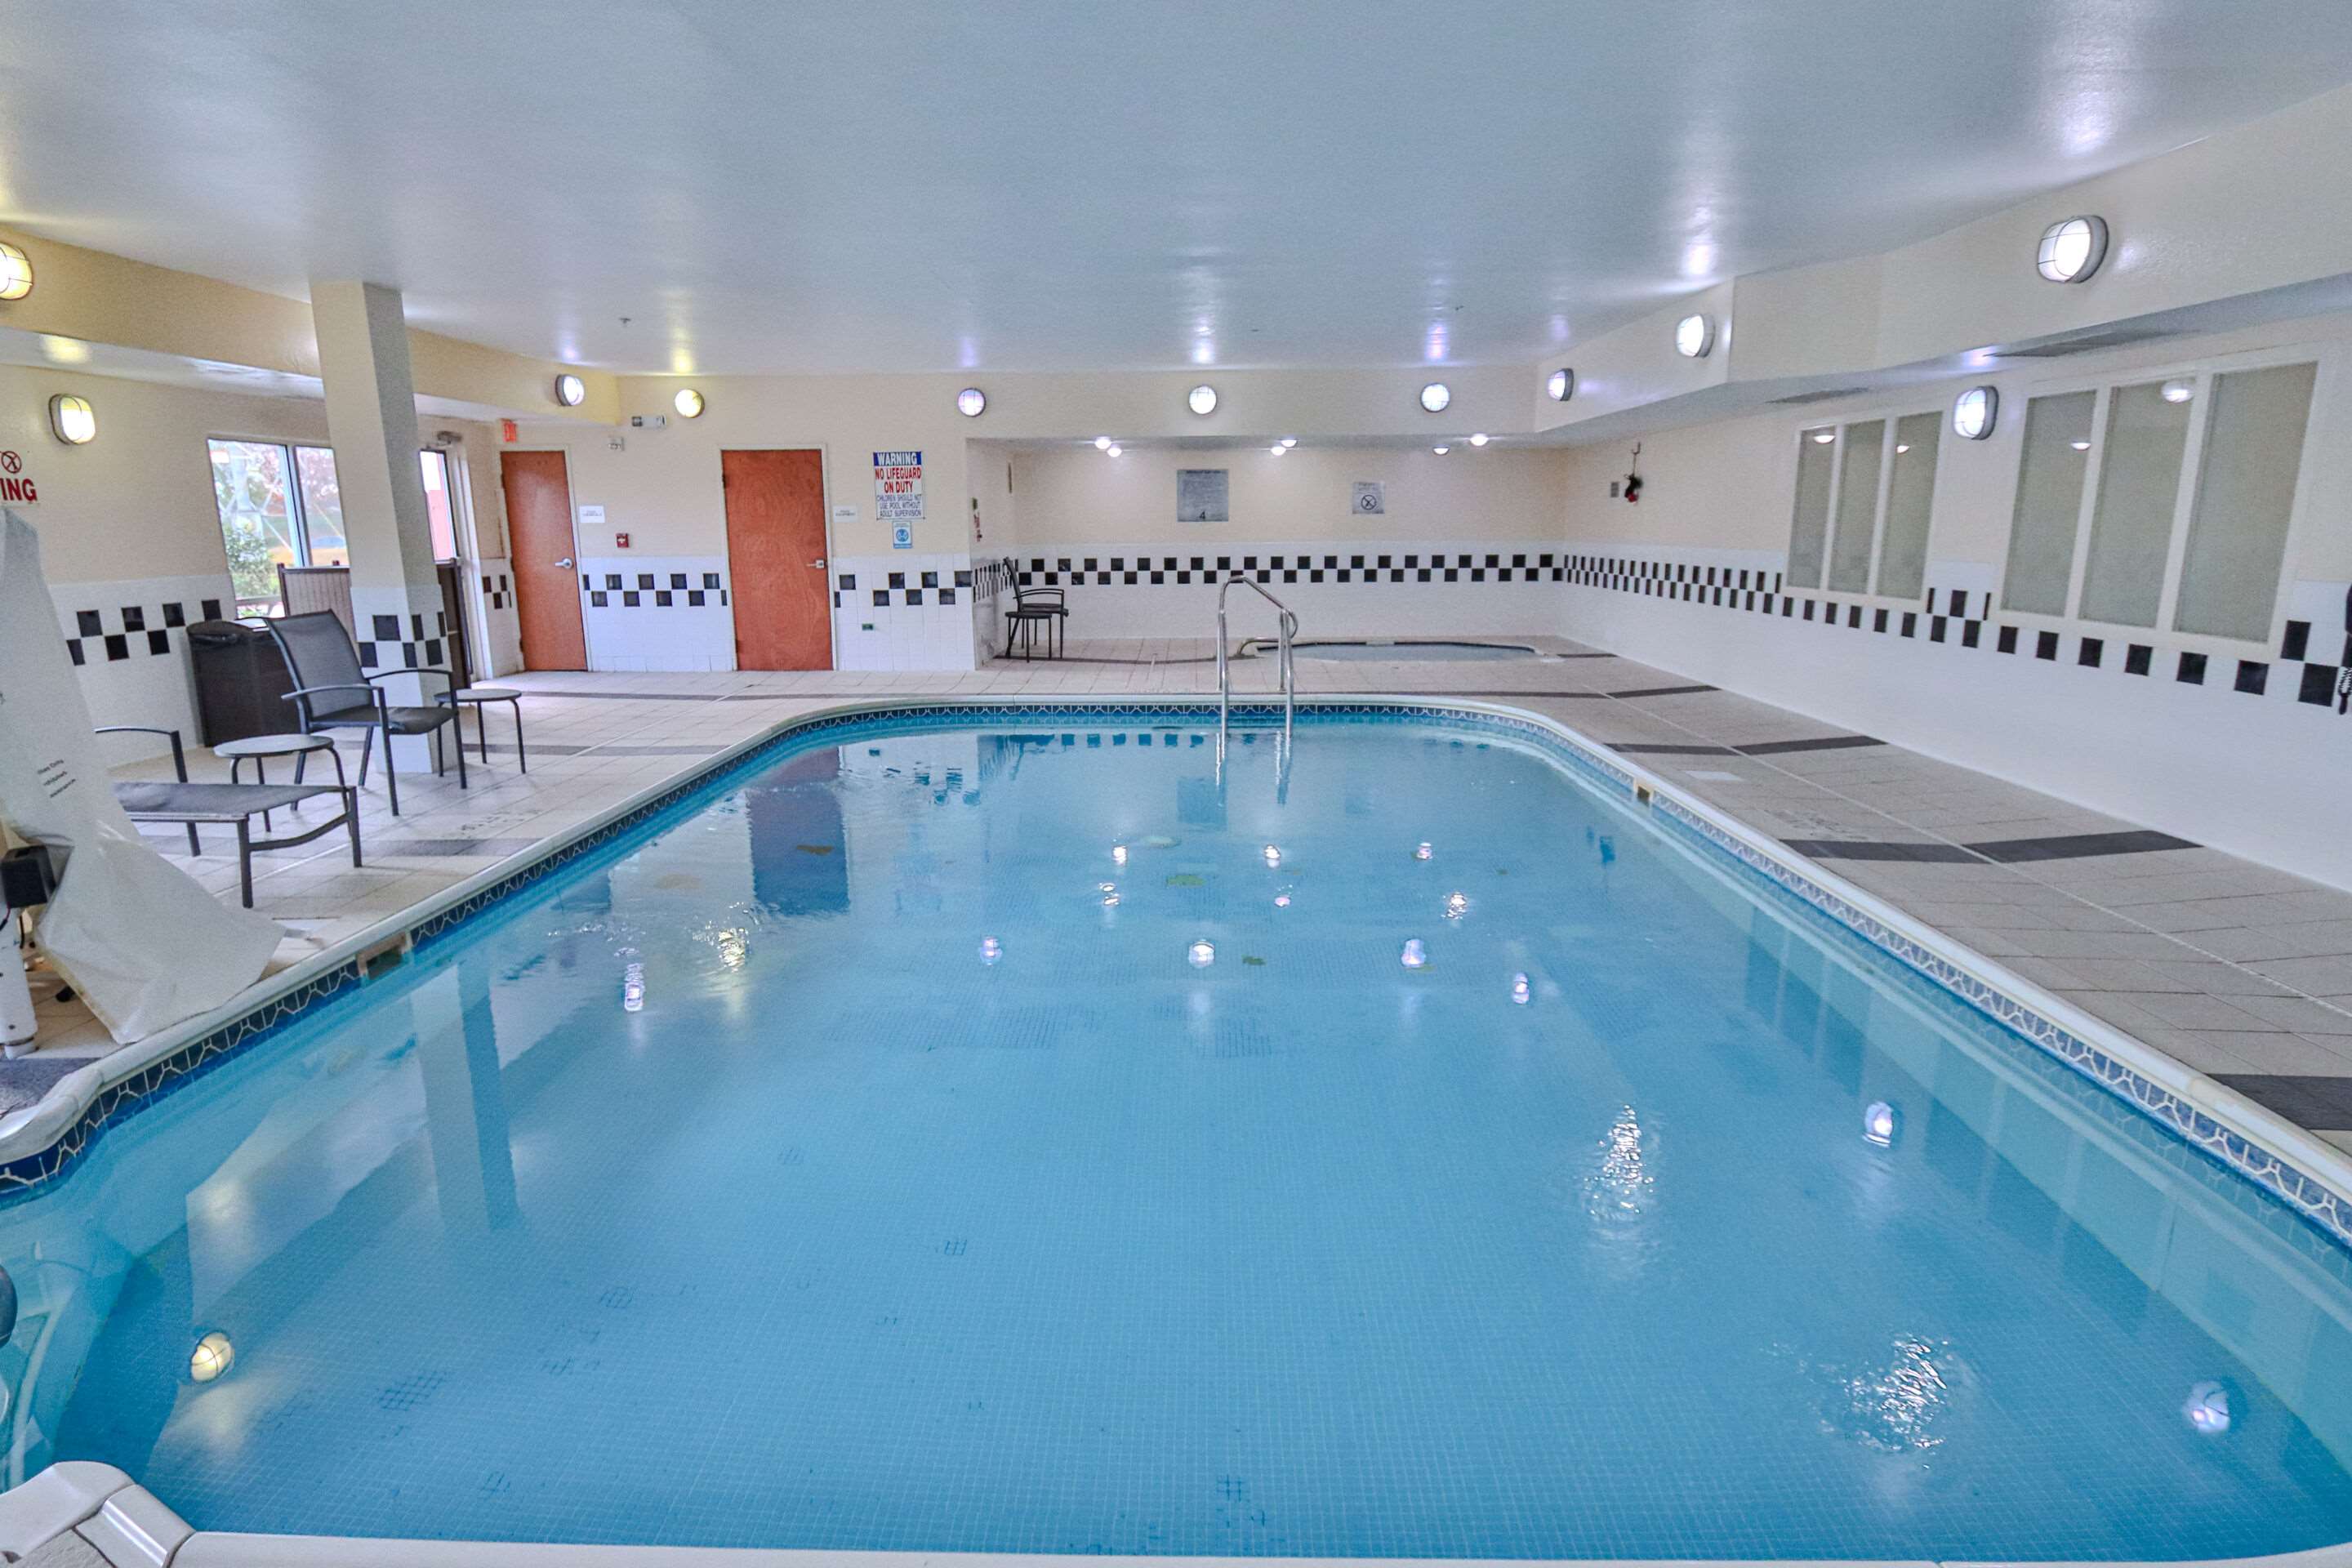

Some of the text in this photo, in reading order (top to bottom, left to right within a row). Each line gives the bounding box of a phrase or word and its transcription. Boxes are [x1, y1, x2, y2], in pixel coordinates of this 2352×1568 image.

[877, 452, 917, 466] WARNING
[875, 467, 921, 480] NO LIFEGUARD
[884, 481, 913, 493] ON DUTY
[894, 509, 922, 517] SUPERVISION
